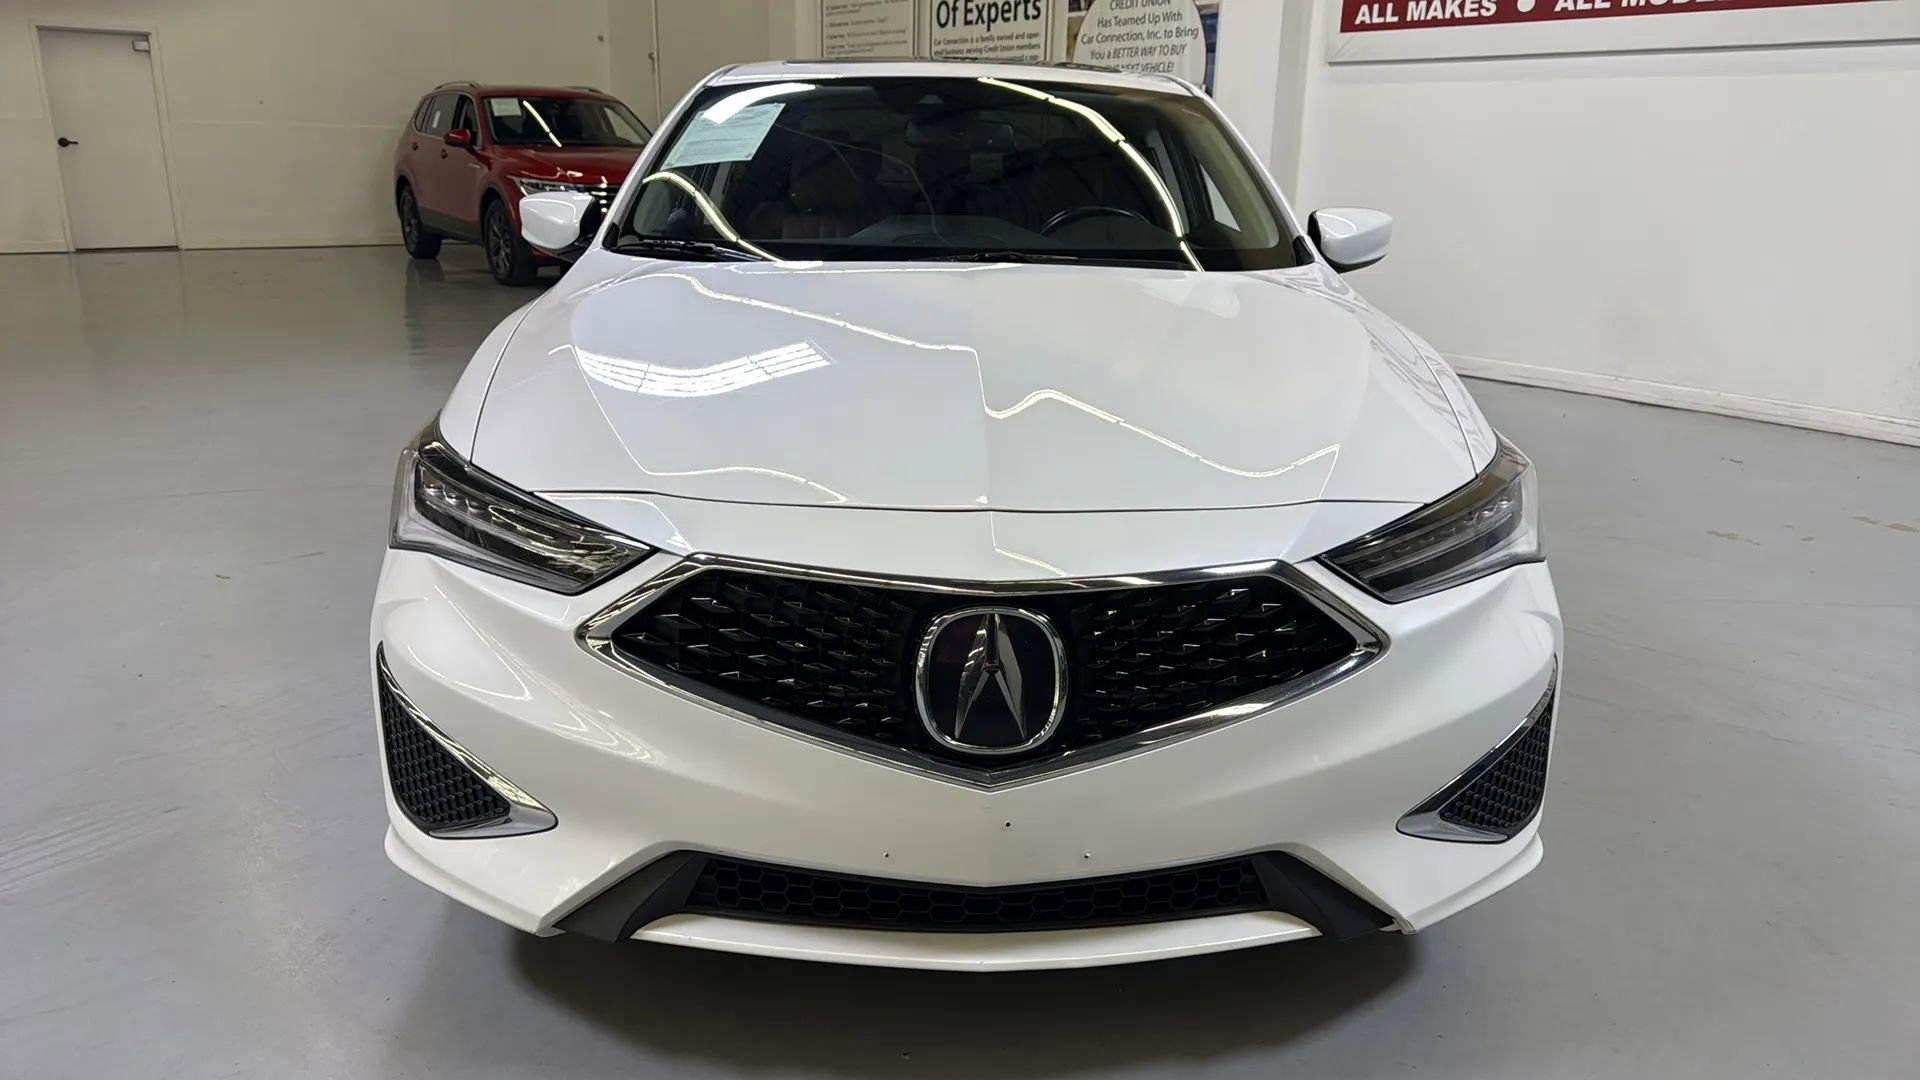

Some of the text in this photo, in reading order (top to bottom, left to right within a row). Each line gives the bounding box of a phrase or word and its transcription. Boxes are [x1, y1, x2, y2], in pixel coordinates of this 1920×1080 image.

[1109, 0, 1140, 11] CREDIT
[1354, 3, 1399, 25] ALL
[1406, 0, 1497, 22] MAKES
[936, 0, 1041, 32] Of Experts
[1097, 10, 1183, 28] Has Teamed Up With
[1081, 26, 1199, 45] Car Connection, Inc. to Bring
[1090, 49, 1105, 60] You
[1112, 46, 1140, 59] BETTER
[1140, 45, 1157, 57] WAY
[1158, 44, 1170, 56] TO
[1170, 43, 1188, 56] BUY
